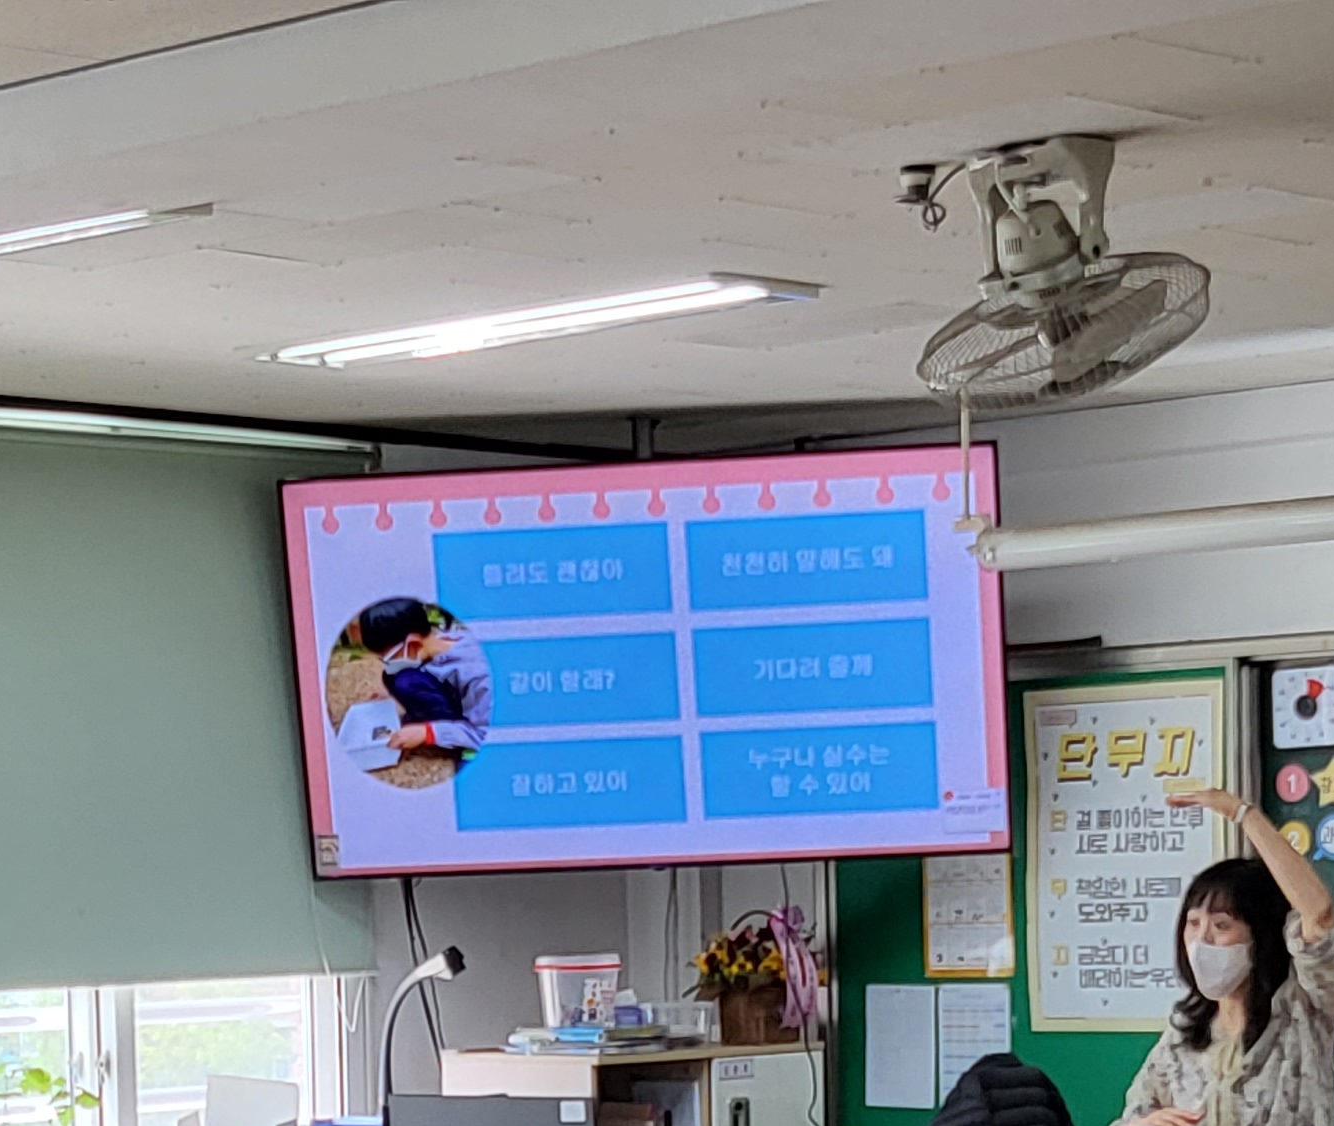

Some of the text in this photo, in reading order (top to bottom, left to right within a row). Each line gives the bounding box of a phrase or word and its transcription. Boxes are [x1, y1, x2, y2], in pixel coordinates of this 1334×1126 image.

[557, 558, 624, 584] 괜찮아
[722, 550, 788, 576] 천천히
[796, 546, 865, 573] 말해도
[509, 669, 616, 695] 같이 할래?
[748, 743, 890, 770] 누구나 실수는
[511, 769, 628, 797] 잘하고 있어
[798, 773, 820, 796] 수
[826, 772, 872, 796] 있어
[1286, 774, 1297, 794] 1
[1112, 830, 1184, 853] 사랑하고
[1078, 902, 1149, 923] 도와주고
[1132, 944, 1149, 965] 더
